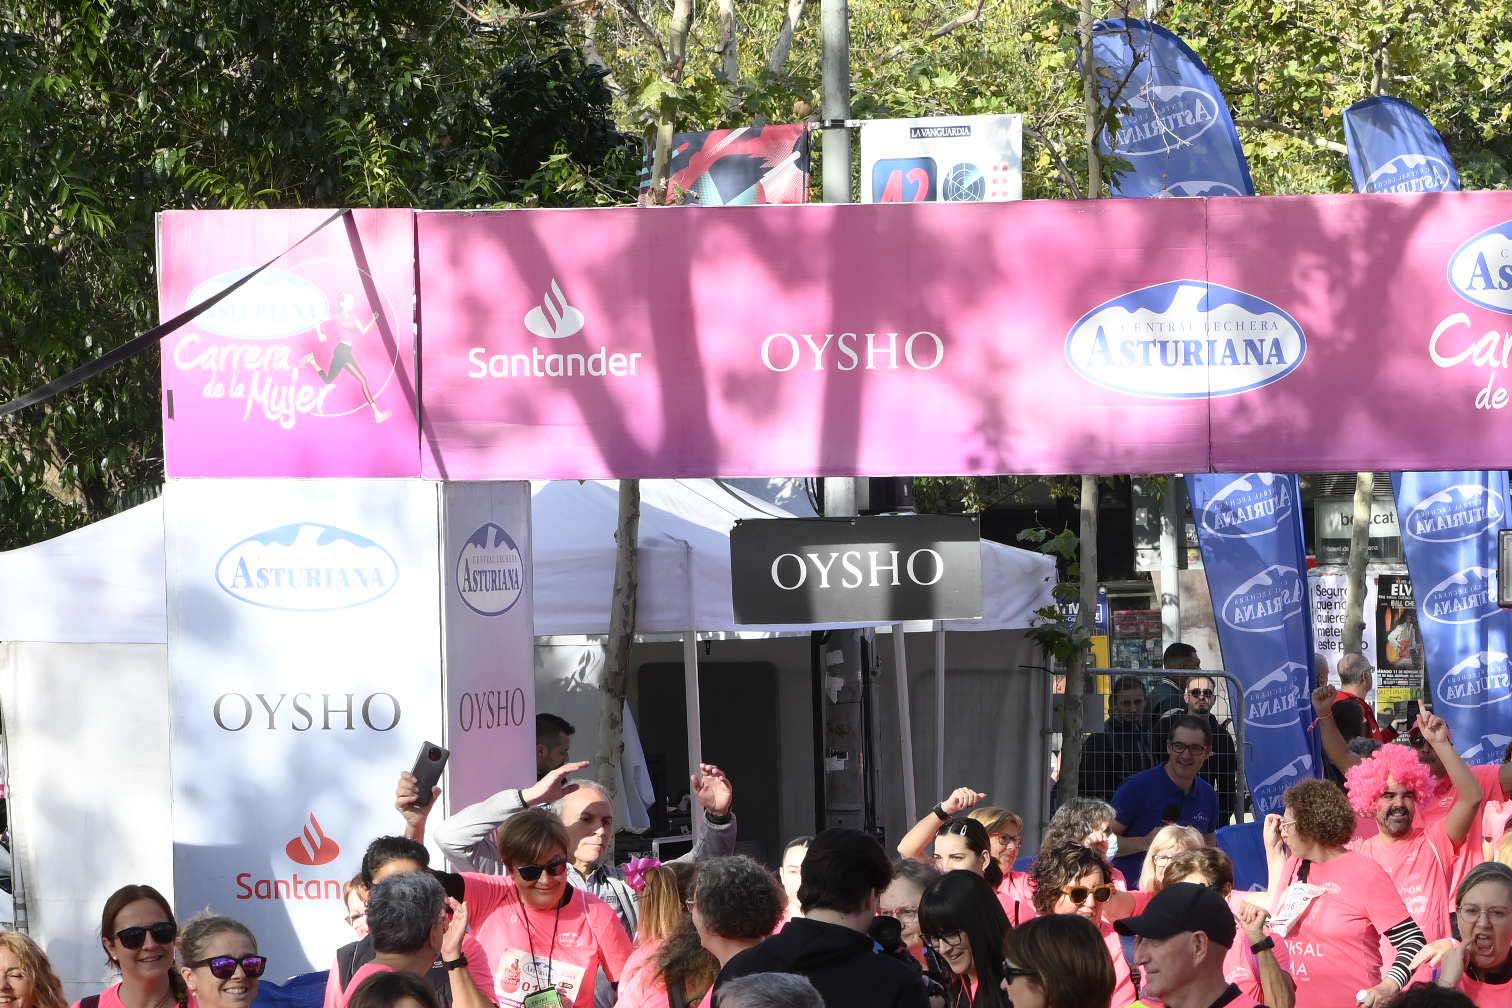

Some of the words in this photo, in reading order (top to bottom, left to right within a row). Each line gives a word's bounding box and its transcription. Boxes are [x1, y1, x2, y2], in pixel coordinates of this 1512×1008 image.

[173, 332, 297, 370] Carrera
[467, 347, 642, 379] Santander
[760, 331, 945, 373] OYSHO
[1087, 325, 1288, 367] ASTURIANA
[202, 371, 225, 398] de
[230, 374, 246, 398] la
[243, 366, 337, 430] Mujer
[1474, 372, 1508, 410] de
[229, 556, 385, 591] ASTURIANA
[461, 558, 521, 593] ASTURIANA
[771, 548, 945, 591] OYSHO
[212, 691, 402, 732] OYSHO
[458, 686, 526, 732] OYSHO
